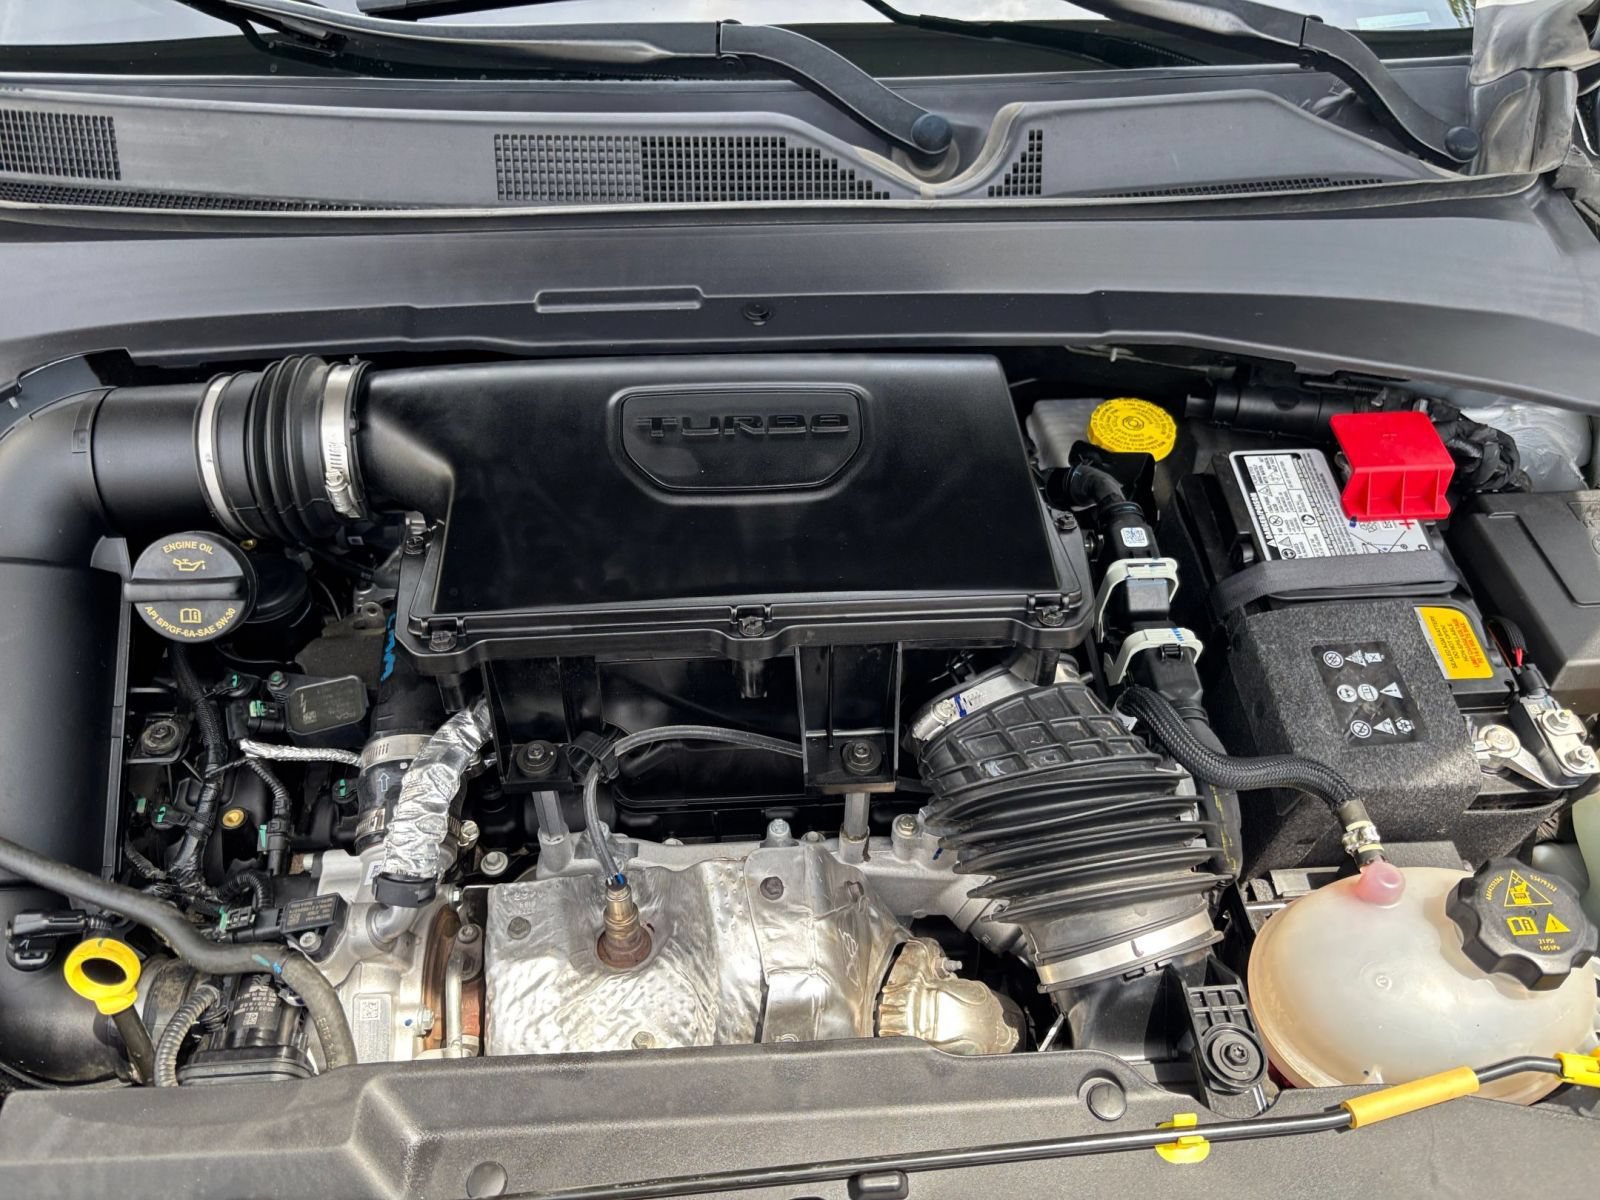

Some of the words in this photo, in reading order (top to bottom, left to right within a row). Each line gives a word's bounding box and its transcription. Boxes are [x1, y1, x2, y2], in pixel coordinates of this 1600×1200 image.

[635, 413, 849, 437] TURBO
[163, 540, 198, 554] ENGINE
[199, 542, 214, 555] OIL
[145, 605, 159, 620] API
[215, 607, 236, 627] 5W-30
[1429, 616, 1442, 636] BATTERY
[1447, 640, 1456, 650] NOT
